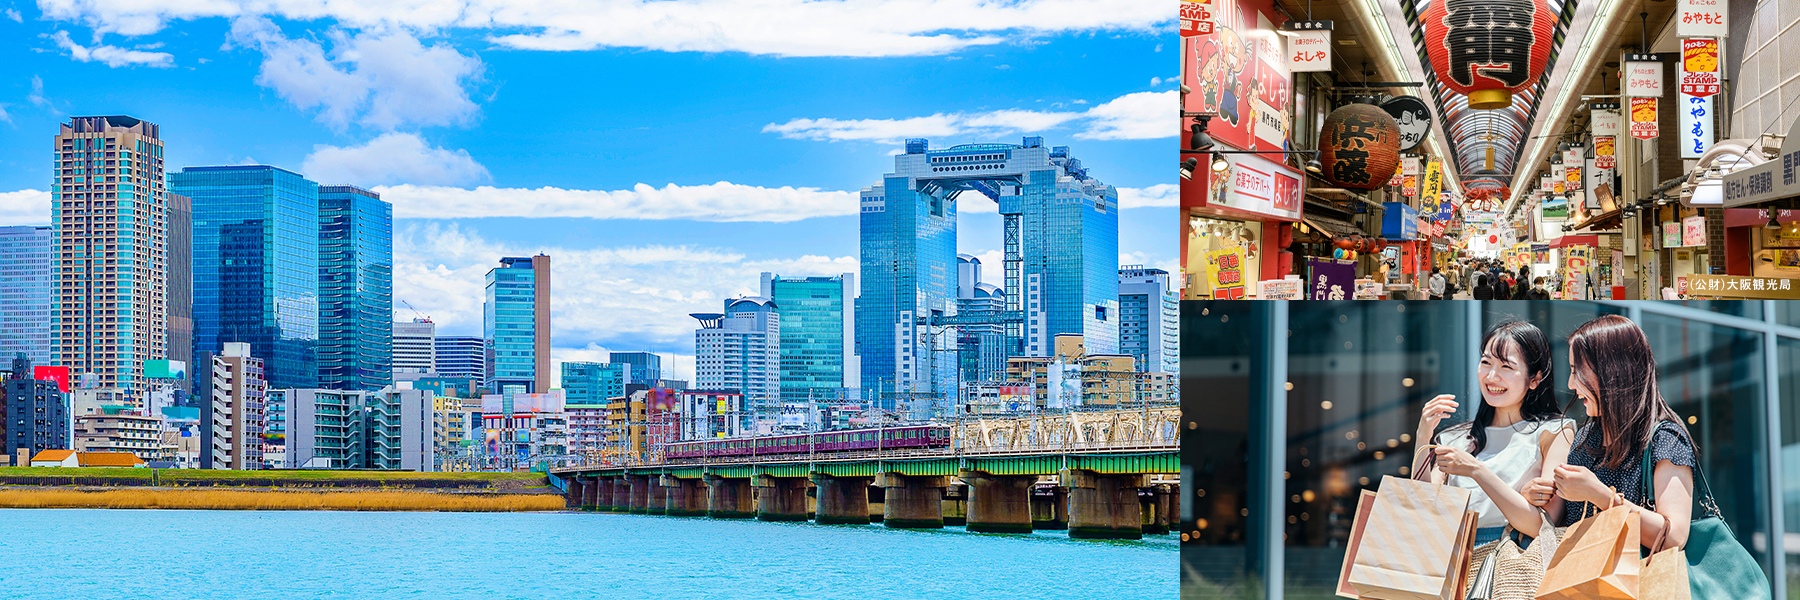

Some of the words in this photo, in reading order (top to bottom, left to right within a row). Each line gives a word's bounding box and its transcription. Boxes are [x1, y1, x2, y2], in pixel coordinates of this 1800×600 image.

[1683, 12, 1722, 24] みやもと
[1685, 41, 1707, 49] クロモン
[1293, 50, 1326, 62] よしや
[1258, 66, 1286, 108] よしや
[1630, 79, 1658, 89] みやもと
[1683, 85, 1718, 93] 加盟店
[1235, 170, 1271, 195] お菓子のデパート
[1726, 169, 1773, 200] 処方せん・保険調剤
[1275, 177, 1298, 208] よしや
